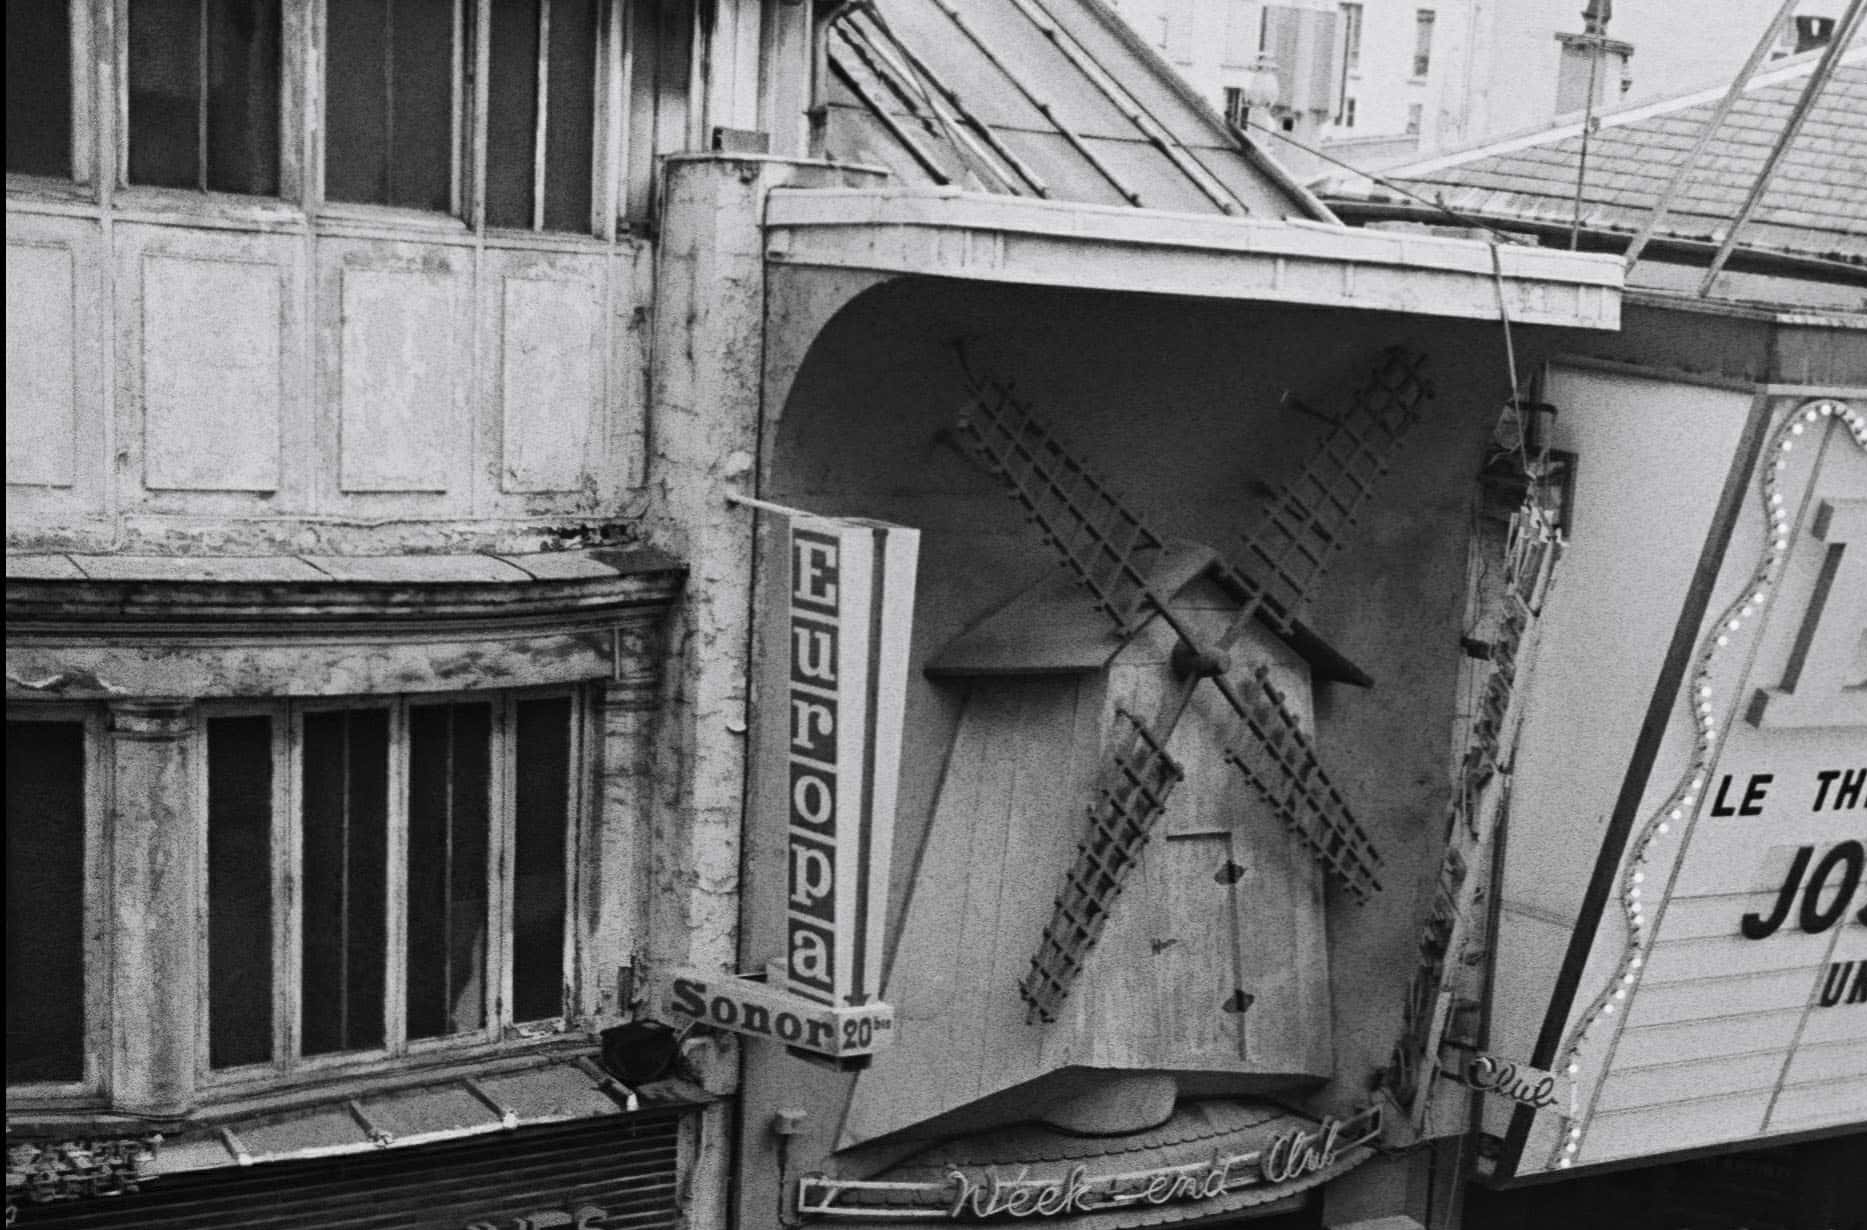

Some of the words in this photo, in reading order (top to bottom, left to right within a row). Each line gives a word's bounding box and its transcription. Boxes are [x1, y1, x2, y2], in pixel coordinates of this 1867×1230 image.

[790, 534, 838, 984] Europa
[1711, 773, 1774, 817] LE
[671, 977, 835, 1048] Sonor
[1466, 1055, 1559, 1109] Club
[1264, 1116, 1340, 1182] Club
